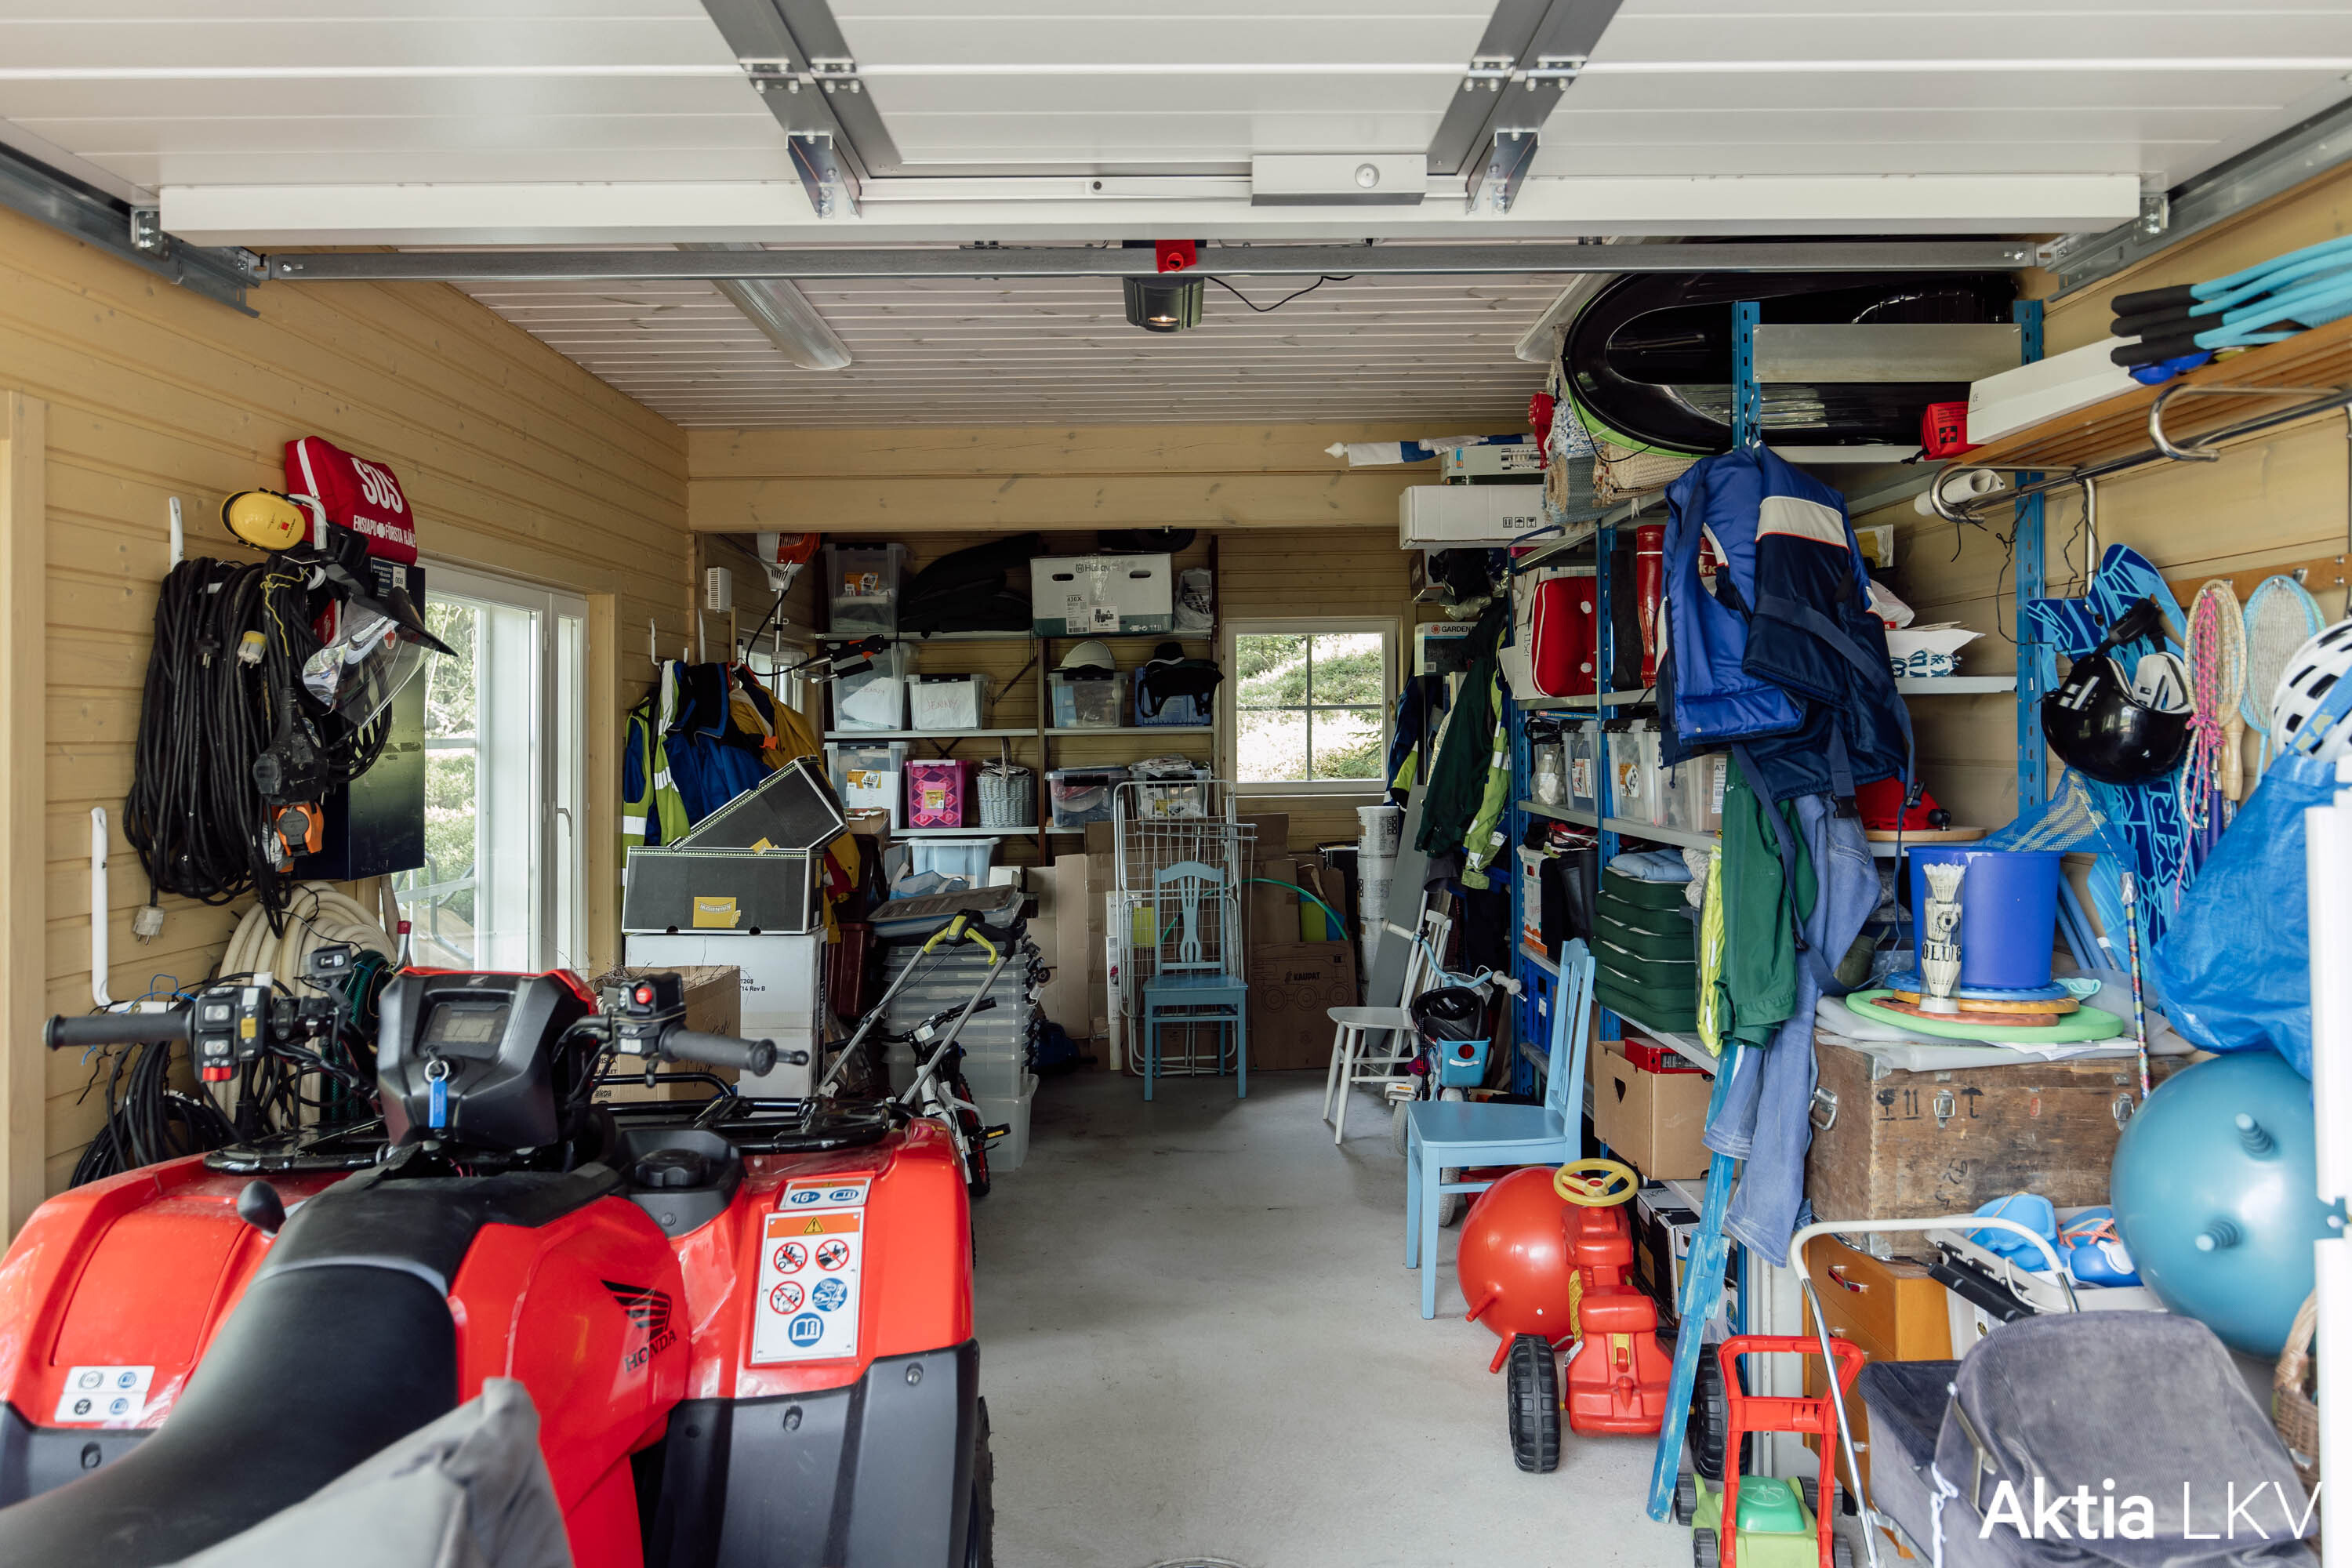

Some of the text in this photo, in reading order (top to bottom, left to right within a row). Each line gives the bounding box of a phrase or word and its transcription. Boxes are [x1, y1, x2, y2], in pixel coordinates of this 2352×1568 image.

[350, 457, 403, 514] SOS
[353, 514, 377, 536] ENSIAPU
[385, 521, 403, 544] FÖRSTA
[698, 902, 731, 913] RAINBOW
[793, 1192, 817, 1203] 16+
[624, 1329, 677, 1372] HONDA
